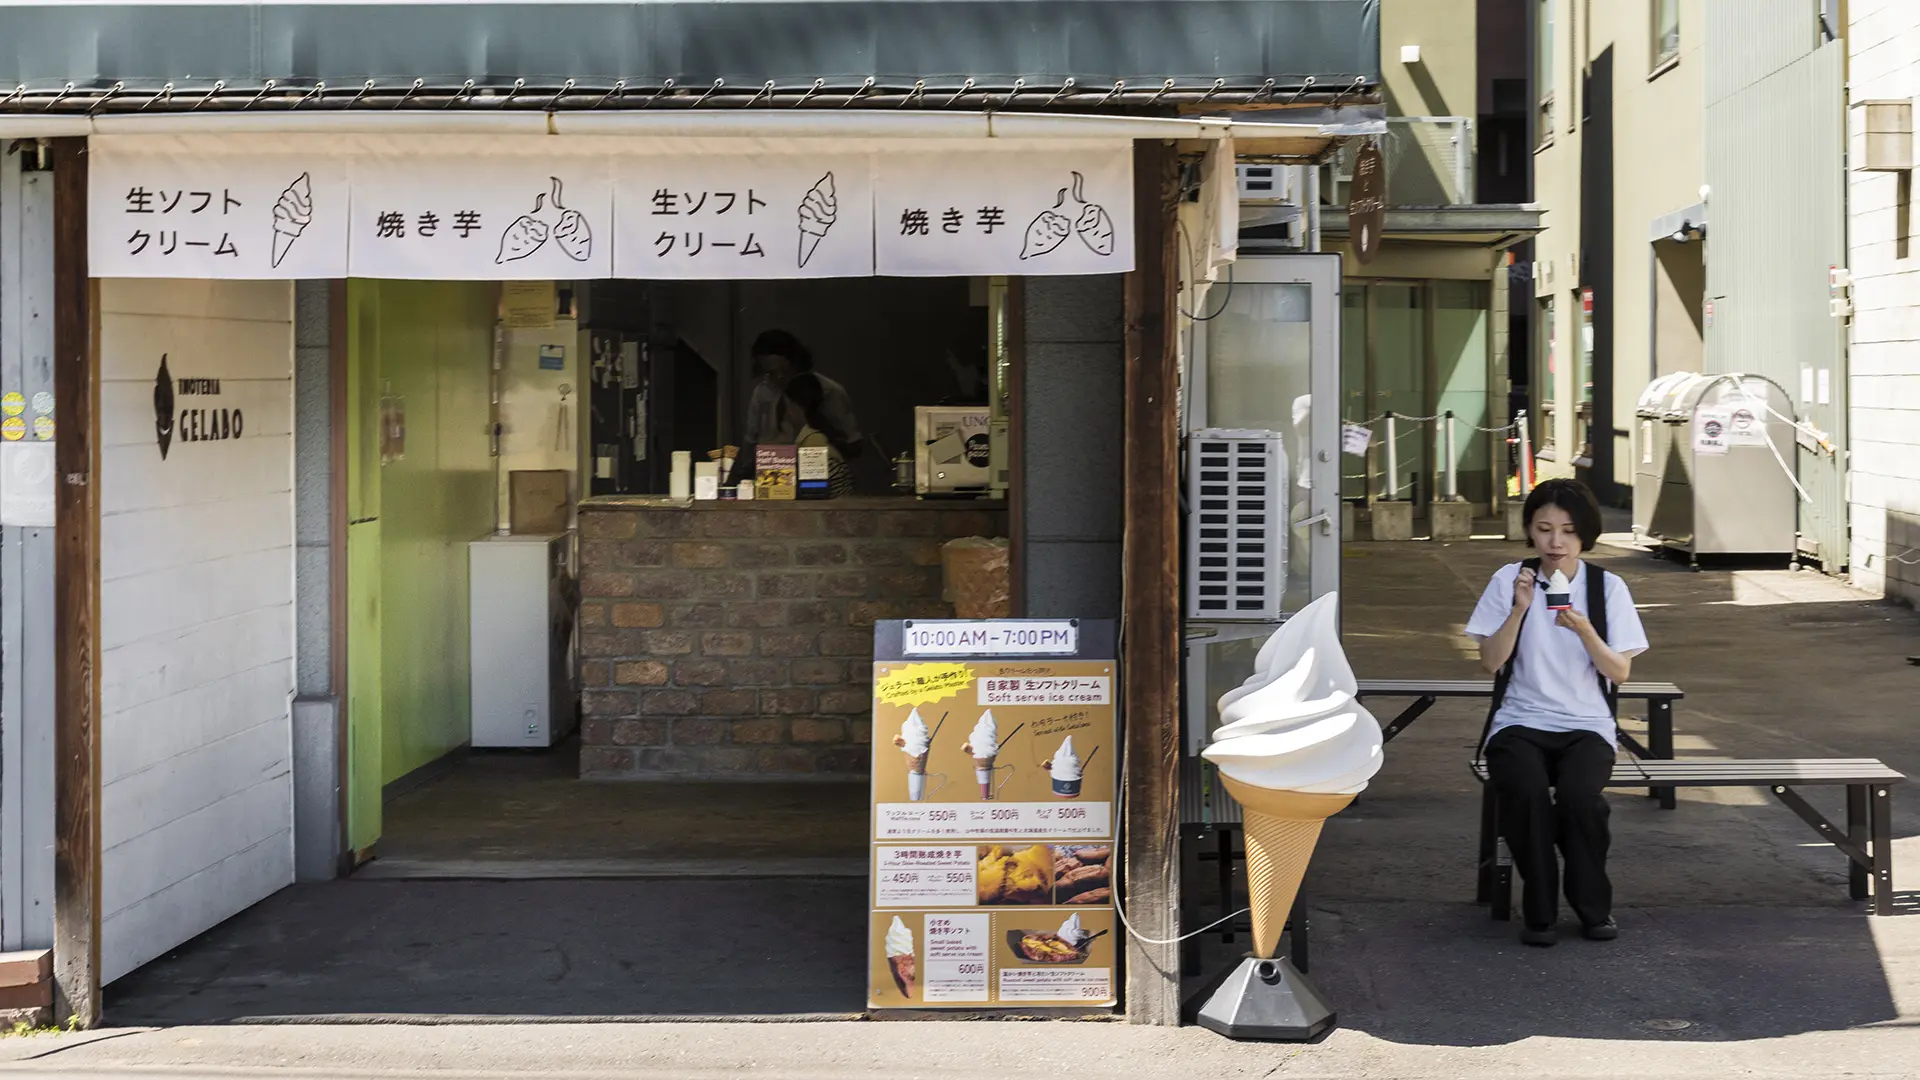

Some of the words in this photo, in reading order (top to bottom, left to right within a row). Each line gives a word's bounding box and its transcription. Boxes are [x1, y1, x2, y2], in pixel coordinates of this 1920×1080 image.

[125, 187, 242, 216] 生ソフト
[650, 189, 767, 217] 生ソフト
[376, 210, 482, 238] 焼き芋
[900, 207, 1005, 236] 焼き芋
[128, 230, 239, 258] クリーム
[654, 231, 765, 258] クリーム
[179, 408, 243, 441] GELABO
[987, 680, 1020, 691] 自家製
[1025, 679, 1101, 690] 生ソフトクリーム
[988, 693, 1011, 702] Soft
[1015, 694, 1045, 702] serve
[1049, 693, 1064, 702] ice
[1068, 694, 1102, 702] cream
[928, 810, 957, 821] 550円
[991, 809, 1019, 820] 500円
[1058, 808, 1087, 819] 500円
[892, 873, 919, 883] 450円
[946, 872, 973, 883] 550円
[958, 963, 984, 974] 600円
